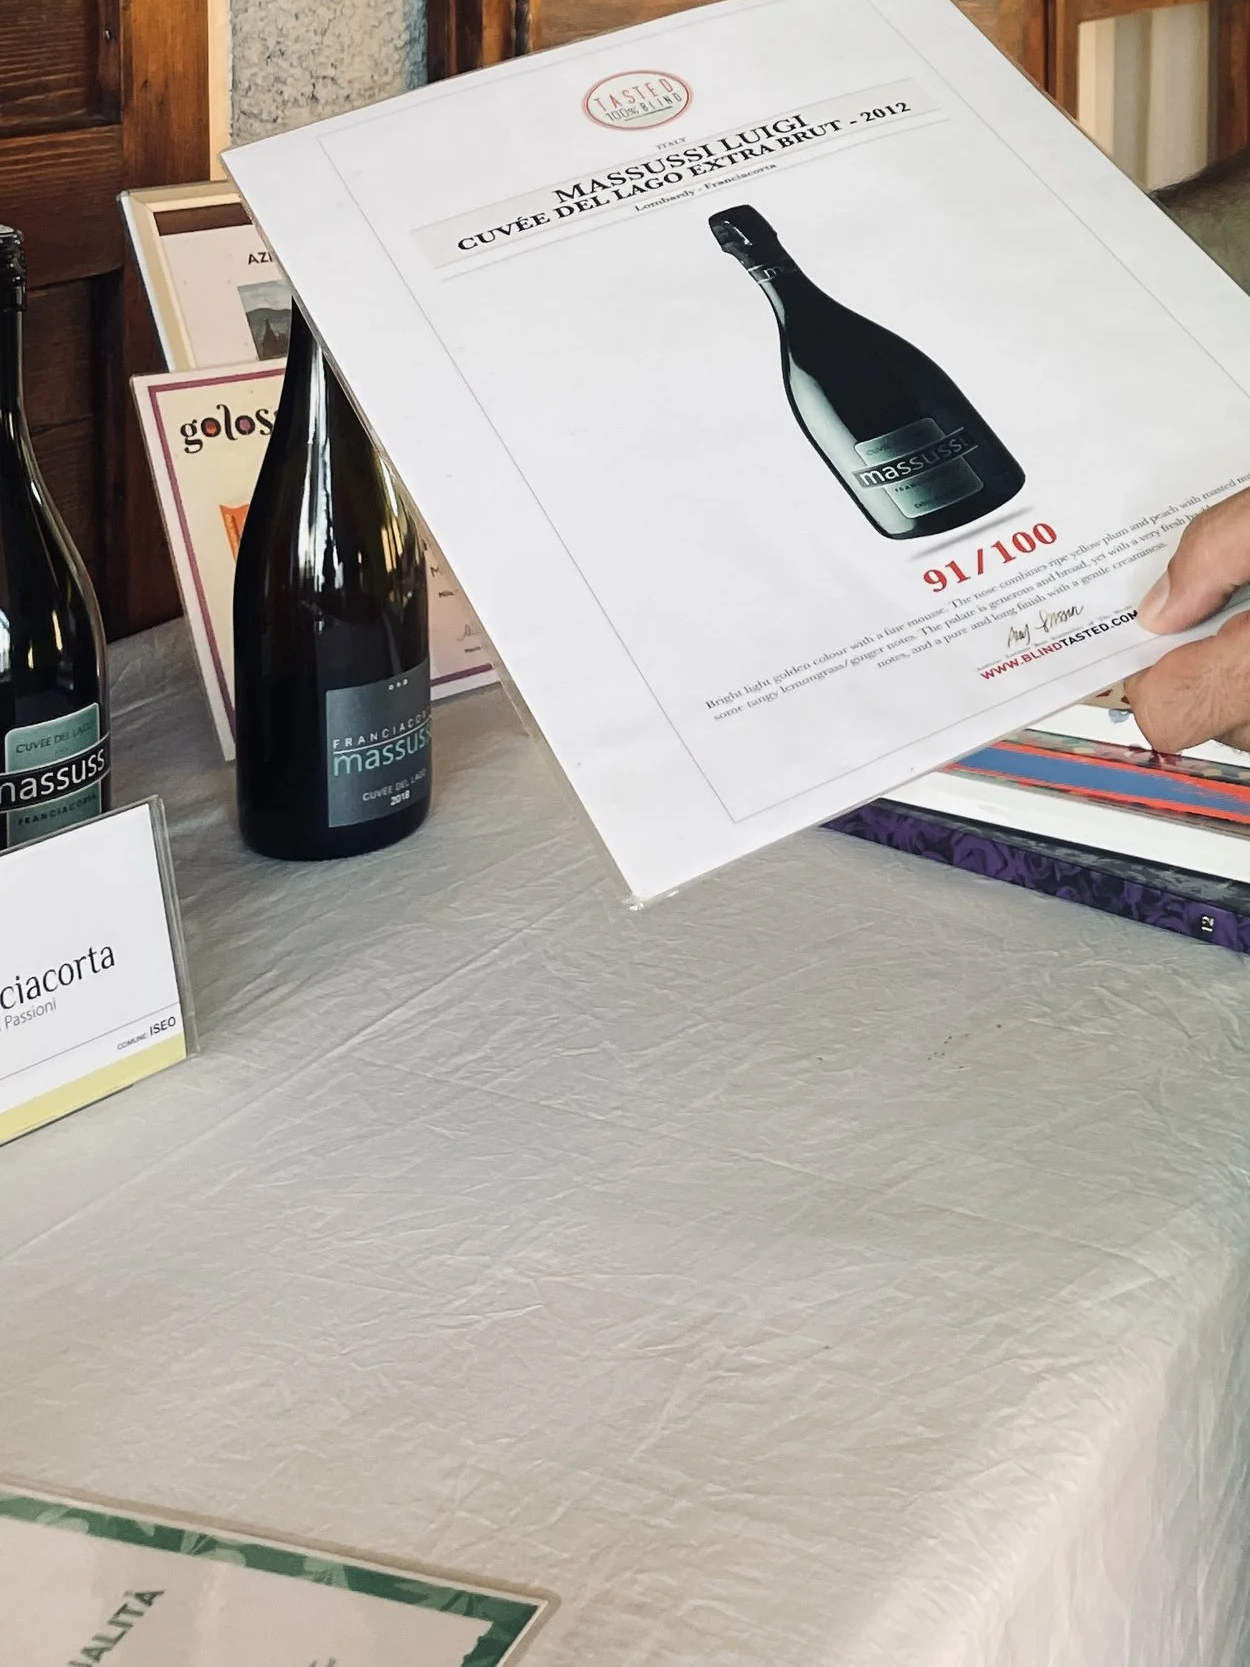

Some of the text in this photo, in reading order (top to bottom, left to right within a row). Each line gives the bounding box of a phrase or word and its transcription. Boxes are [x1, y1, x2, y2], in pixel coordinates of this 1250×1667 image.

[594, 78, 673, 111] TASTED
[605, 92, 682, 122] 100% BLIND
[552, 114, 811, 204] MASSUSSI LUIGI
[656, 137, 686, 150] ITALY
[457, 212, 551, 251] CUVÉE
[552, 195, 611, 219] DEL
[610, 172, 684, 201] LAGO
[686, 144, 775, 177] EXTRA
[775, 119, 844, 149] BRUT
[860, 102, 912, 123] 2012
[634, 190, 695, 212] Lombardy
[704, 164, 777, 190] Franciacorta
[180, 404, 279, 454] golos
[860, 438, 968, 485] massussi
[923, 523, 1057, 593] 91/100
[706, 689, 742, 709] Bright
[744, 678, 772, 694] light
[773, 662, 811, 684] golden
[813, 647, 847, 665] colour
[851, 635, 875, 650] with
[884, 624, 905, 637] fine
[949, 596, 972, 610] The
[974, 586, 999, 599] nose
[999, 564, 1047, 589] combines
[1050, 554, 1068, 570] ripe
[1069, 541, 1101, 561] yellow
[1102, 529, 1130, 547] plum
[1130, 518, 1150, 531] and
[1150, 505, 1179, 525] peach
[1179, 494, 1201, 508] with
[1202, 479, 1236, 500] roasted
[877, 652, 910, 668] notes,
[911, 641, 932, 654] and
[943, 627, 968, 643] pure
[970, 616, 992, 630] and
[991, 607, 1017, 622] long
[1016, 594, 1047, 610] finish
[1046, 583, 1071, 598] with
[1080, 566, 1110, 585] gentle
[714, 705, 745, 721] some
[747, 690, 779, 709] tangy
[918, 623, 942, 636] The
[944, 609, 976, 628] palate
[977, 605, 987, 613] is
[988, 585, 1035, 609] generous
[1035, 574, 1056, 588] and
[1091, 553, 1106, 567] yet
[1108, 542, 1130, 556] with
[1139, 528, 1161, 542] very
[1160, 518, 1185, 532] fresh
[980, 610, 1138, 680] WWW.BLINDTASTED.COM
[1201, 916, 1214, 932] 12
[4, 998, 57, 1029] Passioni
[149, 1016, 177, 1036] ISEO
